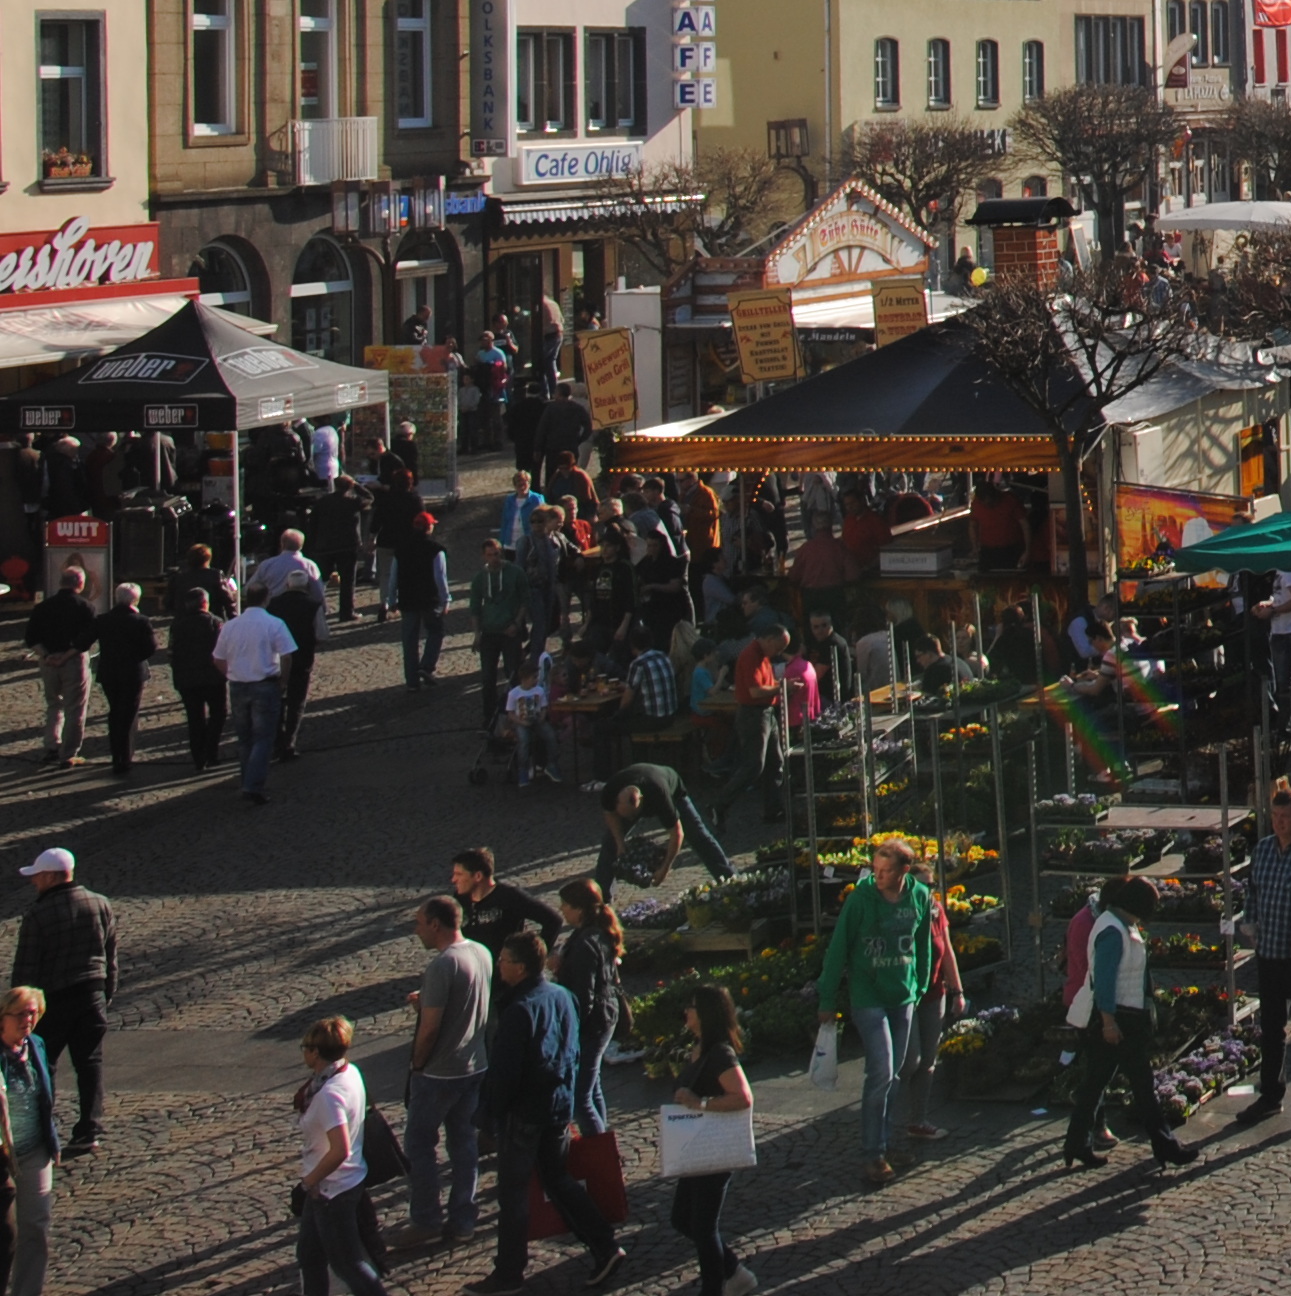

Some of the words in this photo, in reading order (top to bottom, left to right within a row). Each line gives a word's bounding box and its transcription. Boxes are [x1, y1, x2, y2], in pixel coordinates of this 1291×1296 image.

[535, 154, 578, 178] Cafe
[585, 151, 631, 177] Ohlig
[92, 354, 177, 380] weber
[26, 407, 61, 426] weber
[148, 406, 184, 425] weber
[608, 407, 625, 420] Grill
[57, 521, 99, 537] WITT
